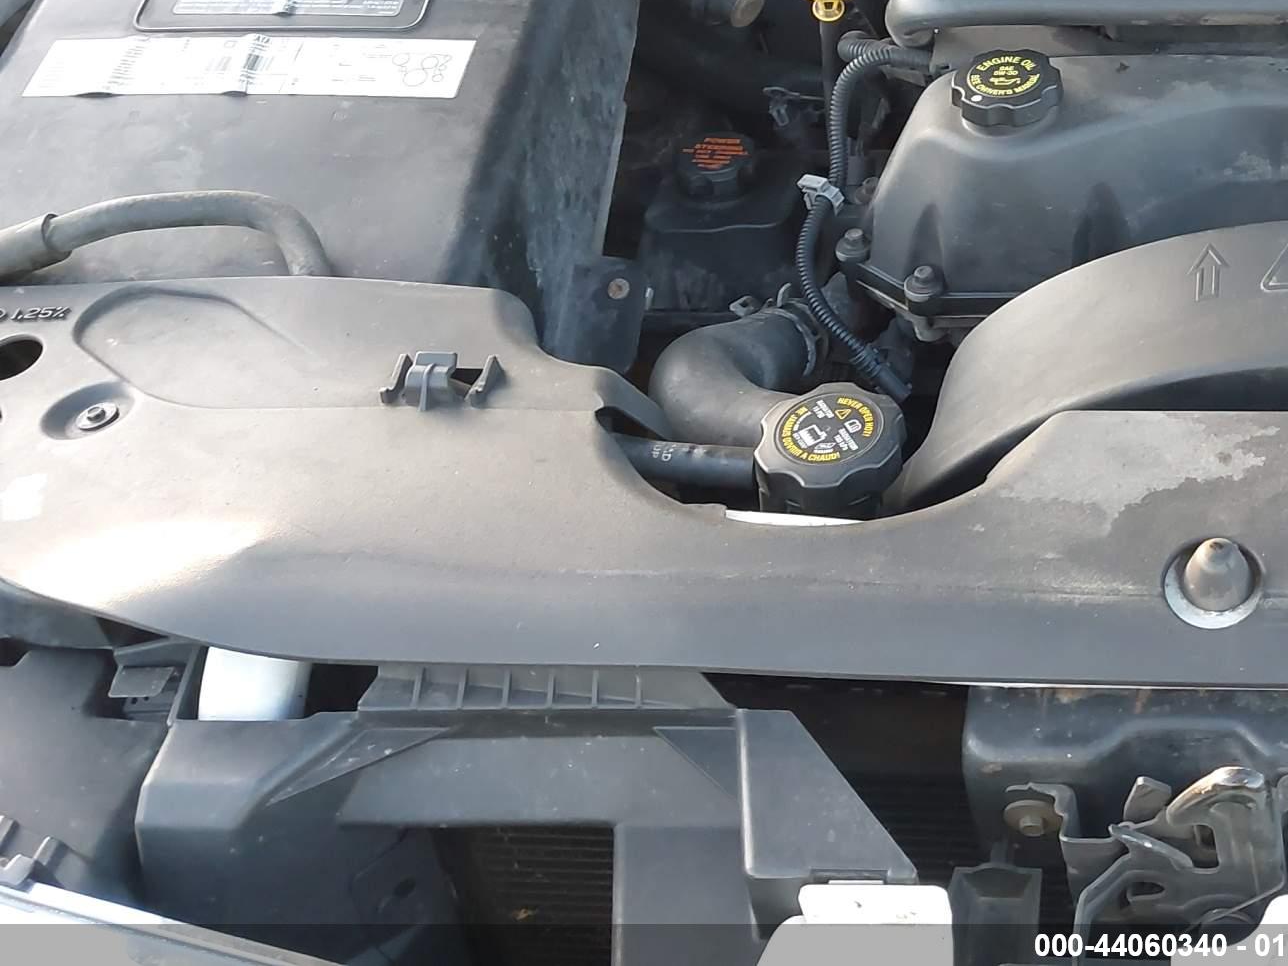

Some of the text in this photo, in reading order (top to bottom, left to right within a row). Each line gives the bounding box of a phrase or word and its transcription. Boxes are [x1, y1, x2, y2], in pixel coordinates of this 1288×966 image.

[976, 56, 1037, 71] ENGINE OIL
[10, 306, 70, 322] 1.25%
[837, 397, 863, 409] NEVER
[859, 406, 874, 422] OPEN
[807, 451, 841, 462] CHAUD!
